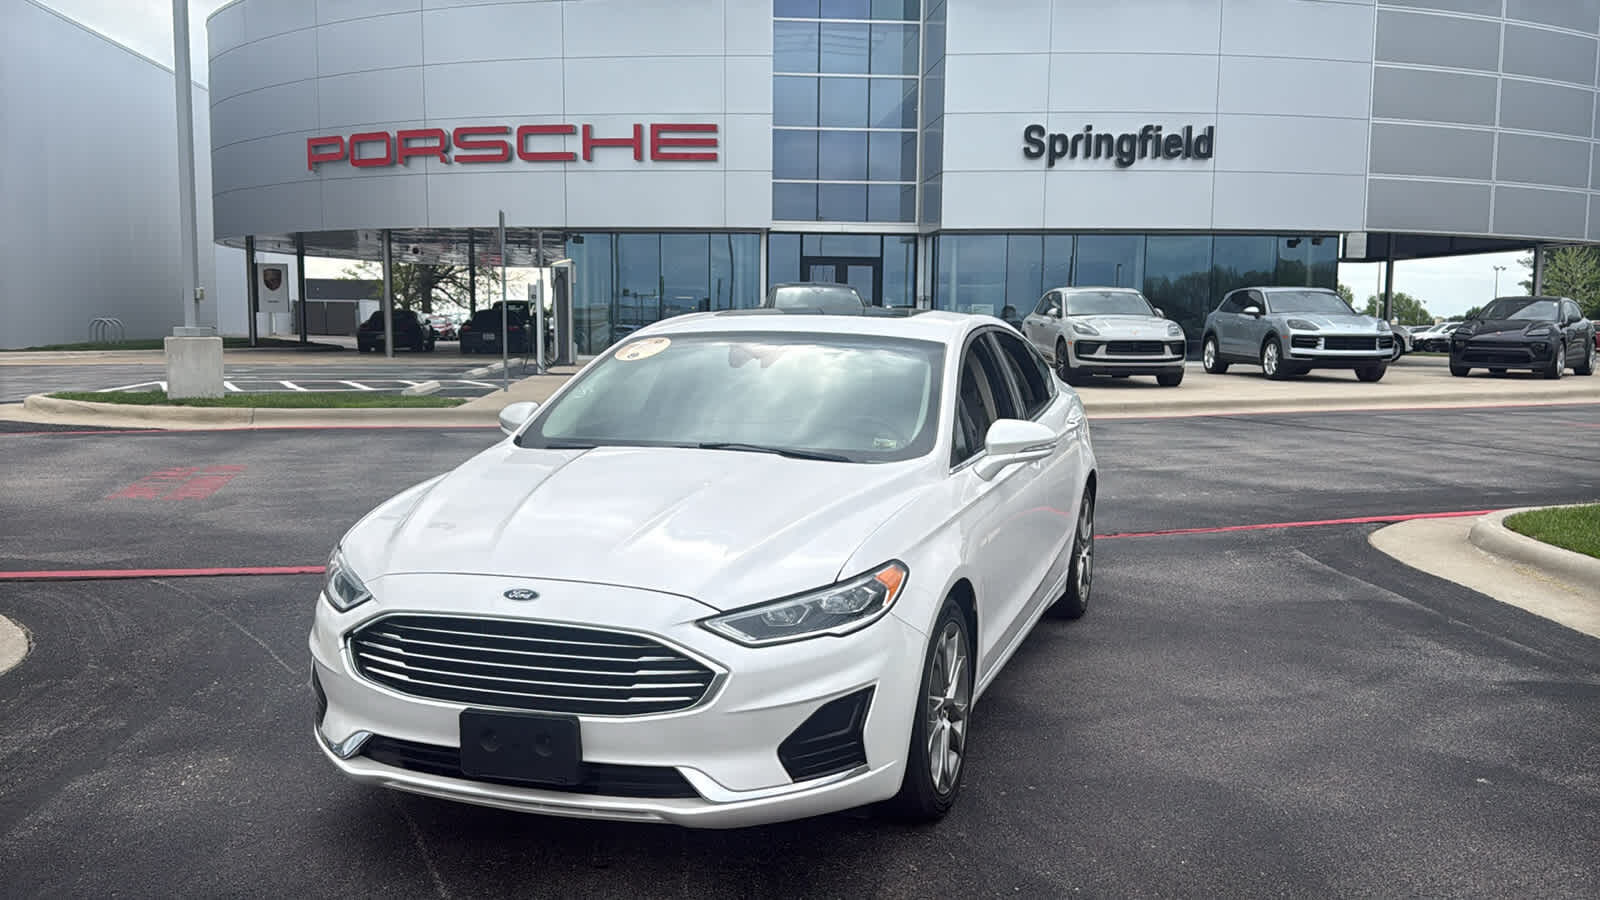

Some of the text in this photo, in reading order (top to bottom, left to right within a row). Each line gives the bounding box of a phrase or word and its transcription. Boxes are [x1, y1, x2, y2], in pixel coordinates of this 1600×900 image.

[307, 123, 719, 172] PORSCHE
[1023, 124, 1215, 168] Springfield
[507, 590, 535, 600] Ford
